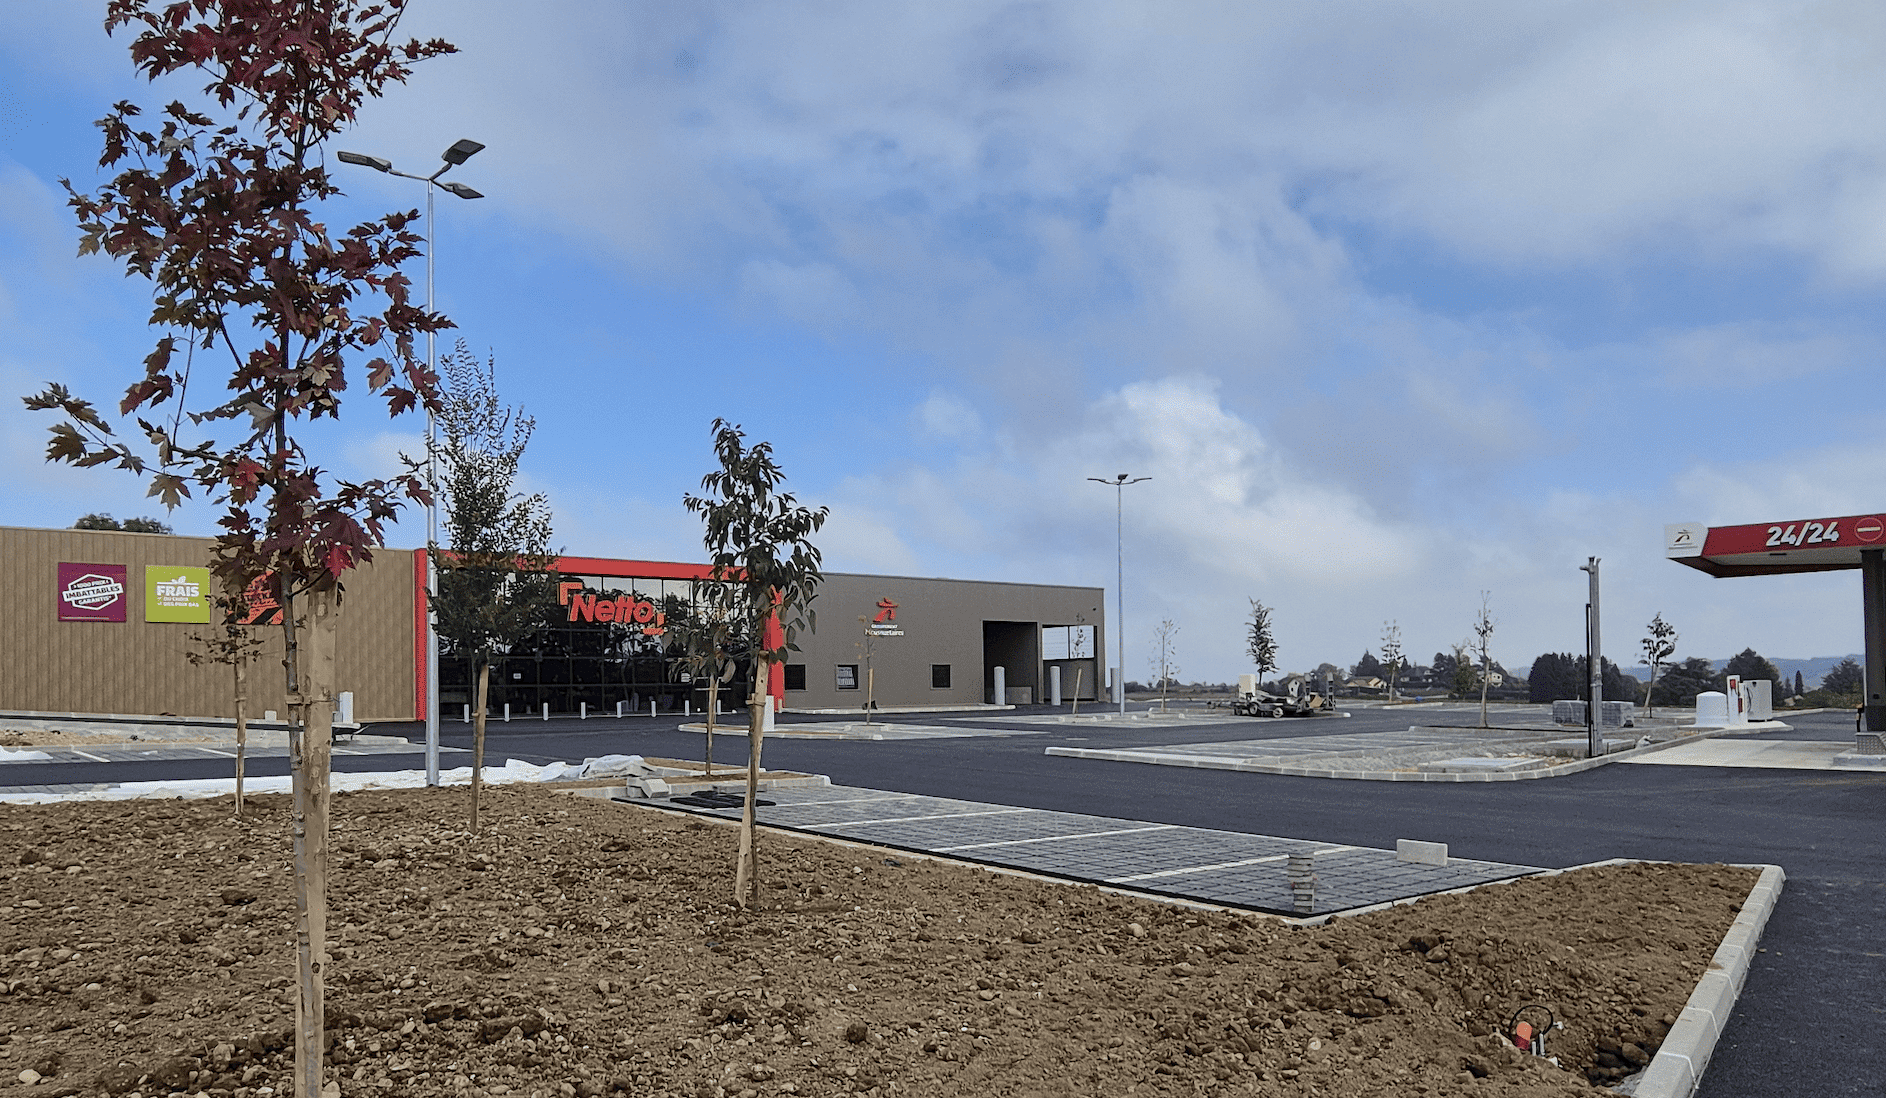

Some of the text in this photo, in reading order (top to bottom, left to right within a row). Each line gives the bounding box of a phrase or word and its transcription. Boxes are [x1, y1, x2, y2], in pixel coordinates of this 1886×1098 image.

[1765, 521, 1840, 547] 24/24
[65, 585, 120, 599] IMBATTABLES
[156, 585, 200, 597] FRAIS
[569, 593, 654, 624] Netto
